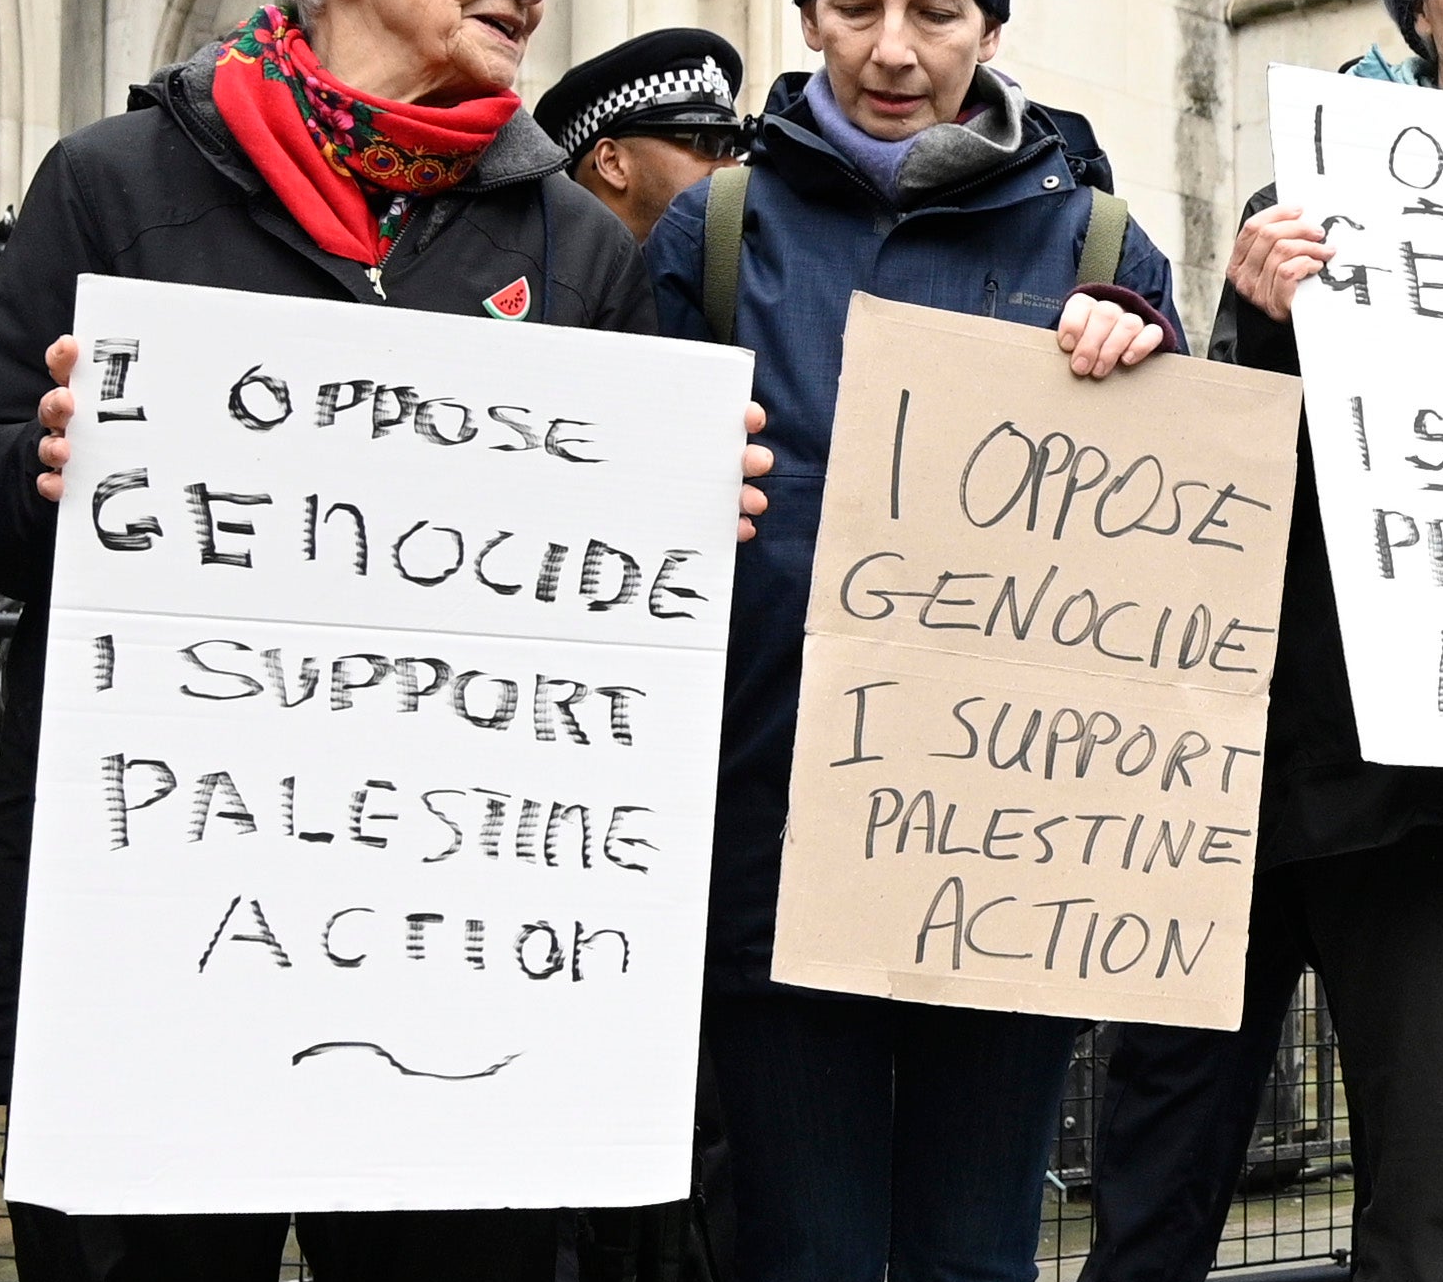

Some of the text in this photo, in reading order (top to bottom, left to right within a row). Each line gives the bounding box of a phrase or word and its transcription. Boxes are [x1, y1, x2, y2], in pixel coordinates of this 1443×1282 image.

[1314, 105, 1325, 175] I
[94, 338, 609, 463] I OPPOSE
[1349, 396, 1371, 471] I
[891, 389, 1272, 552] I OPPOSE
[840, 551, 1276, 674] GENOCIDE
[94, 635, 647, 746] I SUPPORT
[830, 681, 1261, 792] I SUPPORT
[866, 788, 1251, 874] PALESTINE
[916, 876, 1214, 979] ACTION
